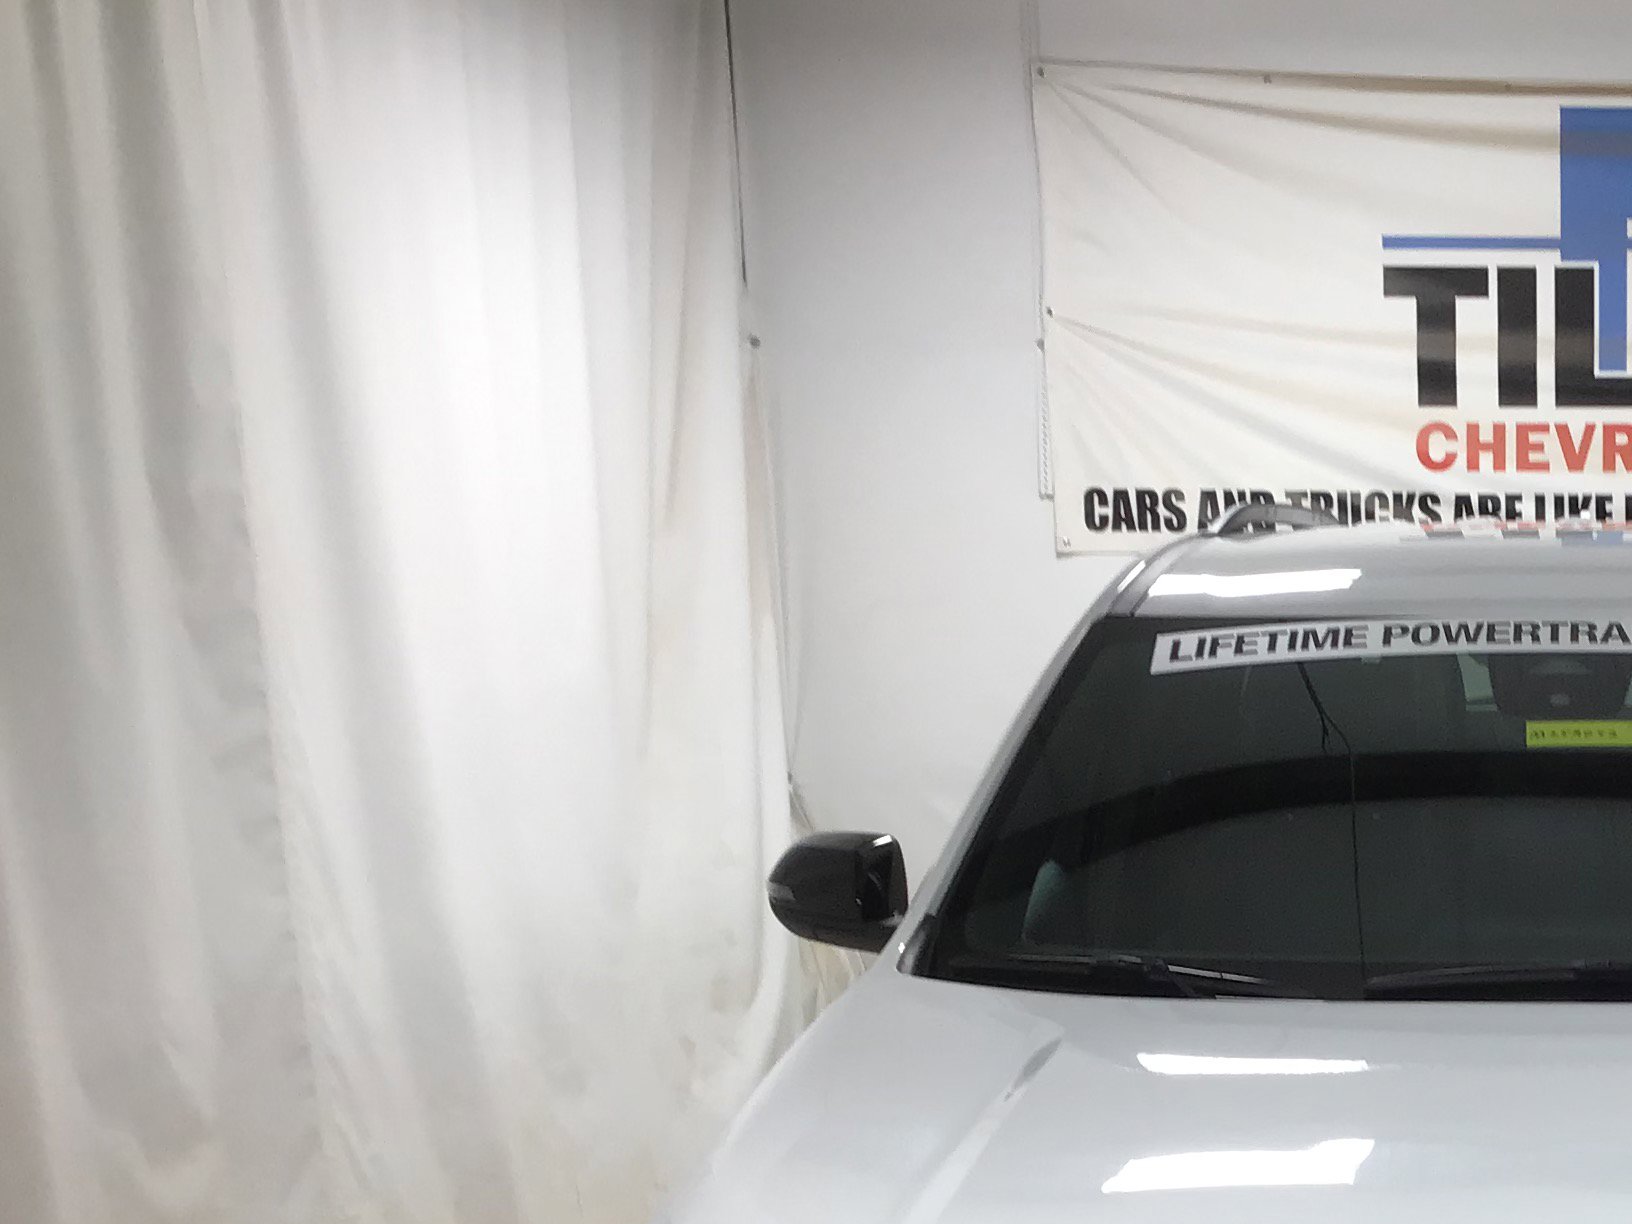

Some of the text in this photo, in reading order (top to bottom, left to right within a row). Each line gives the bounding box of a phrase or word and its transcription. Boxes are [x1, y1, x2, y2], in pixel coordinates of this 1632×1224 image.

[1083, 487, 1187, 533] CARS
[1454, 492, 1523, 522] ARE
[1534, 492, 1613, 523] LIKE
[1169, 624, 1370, 663] LIFETIME
